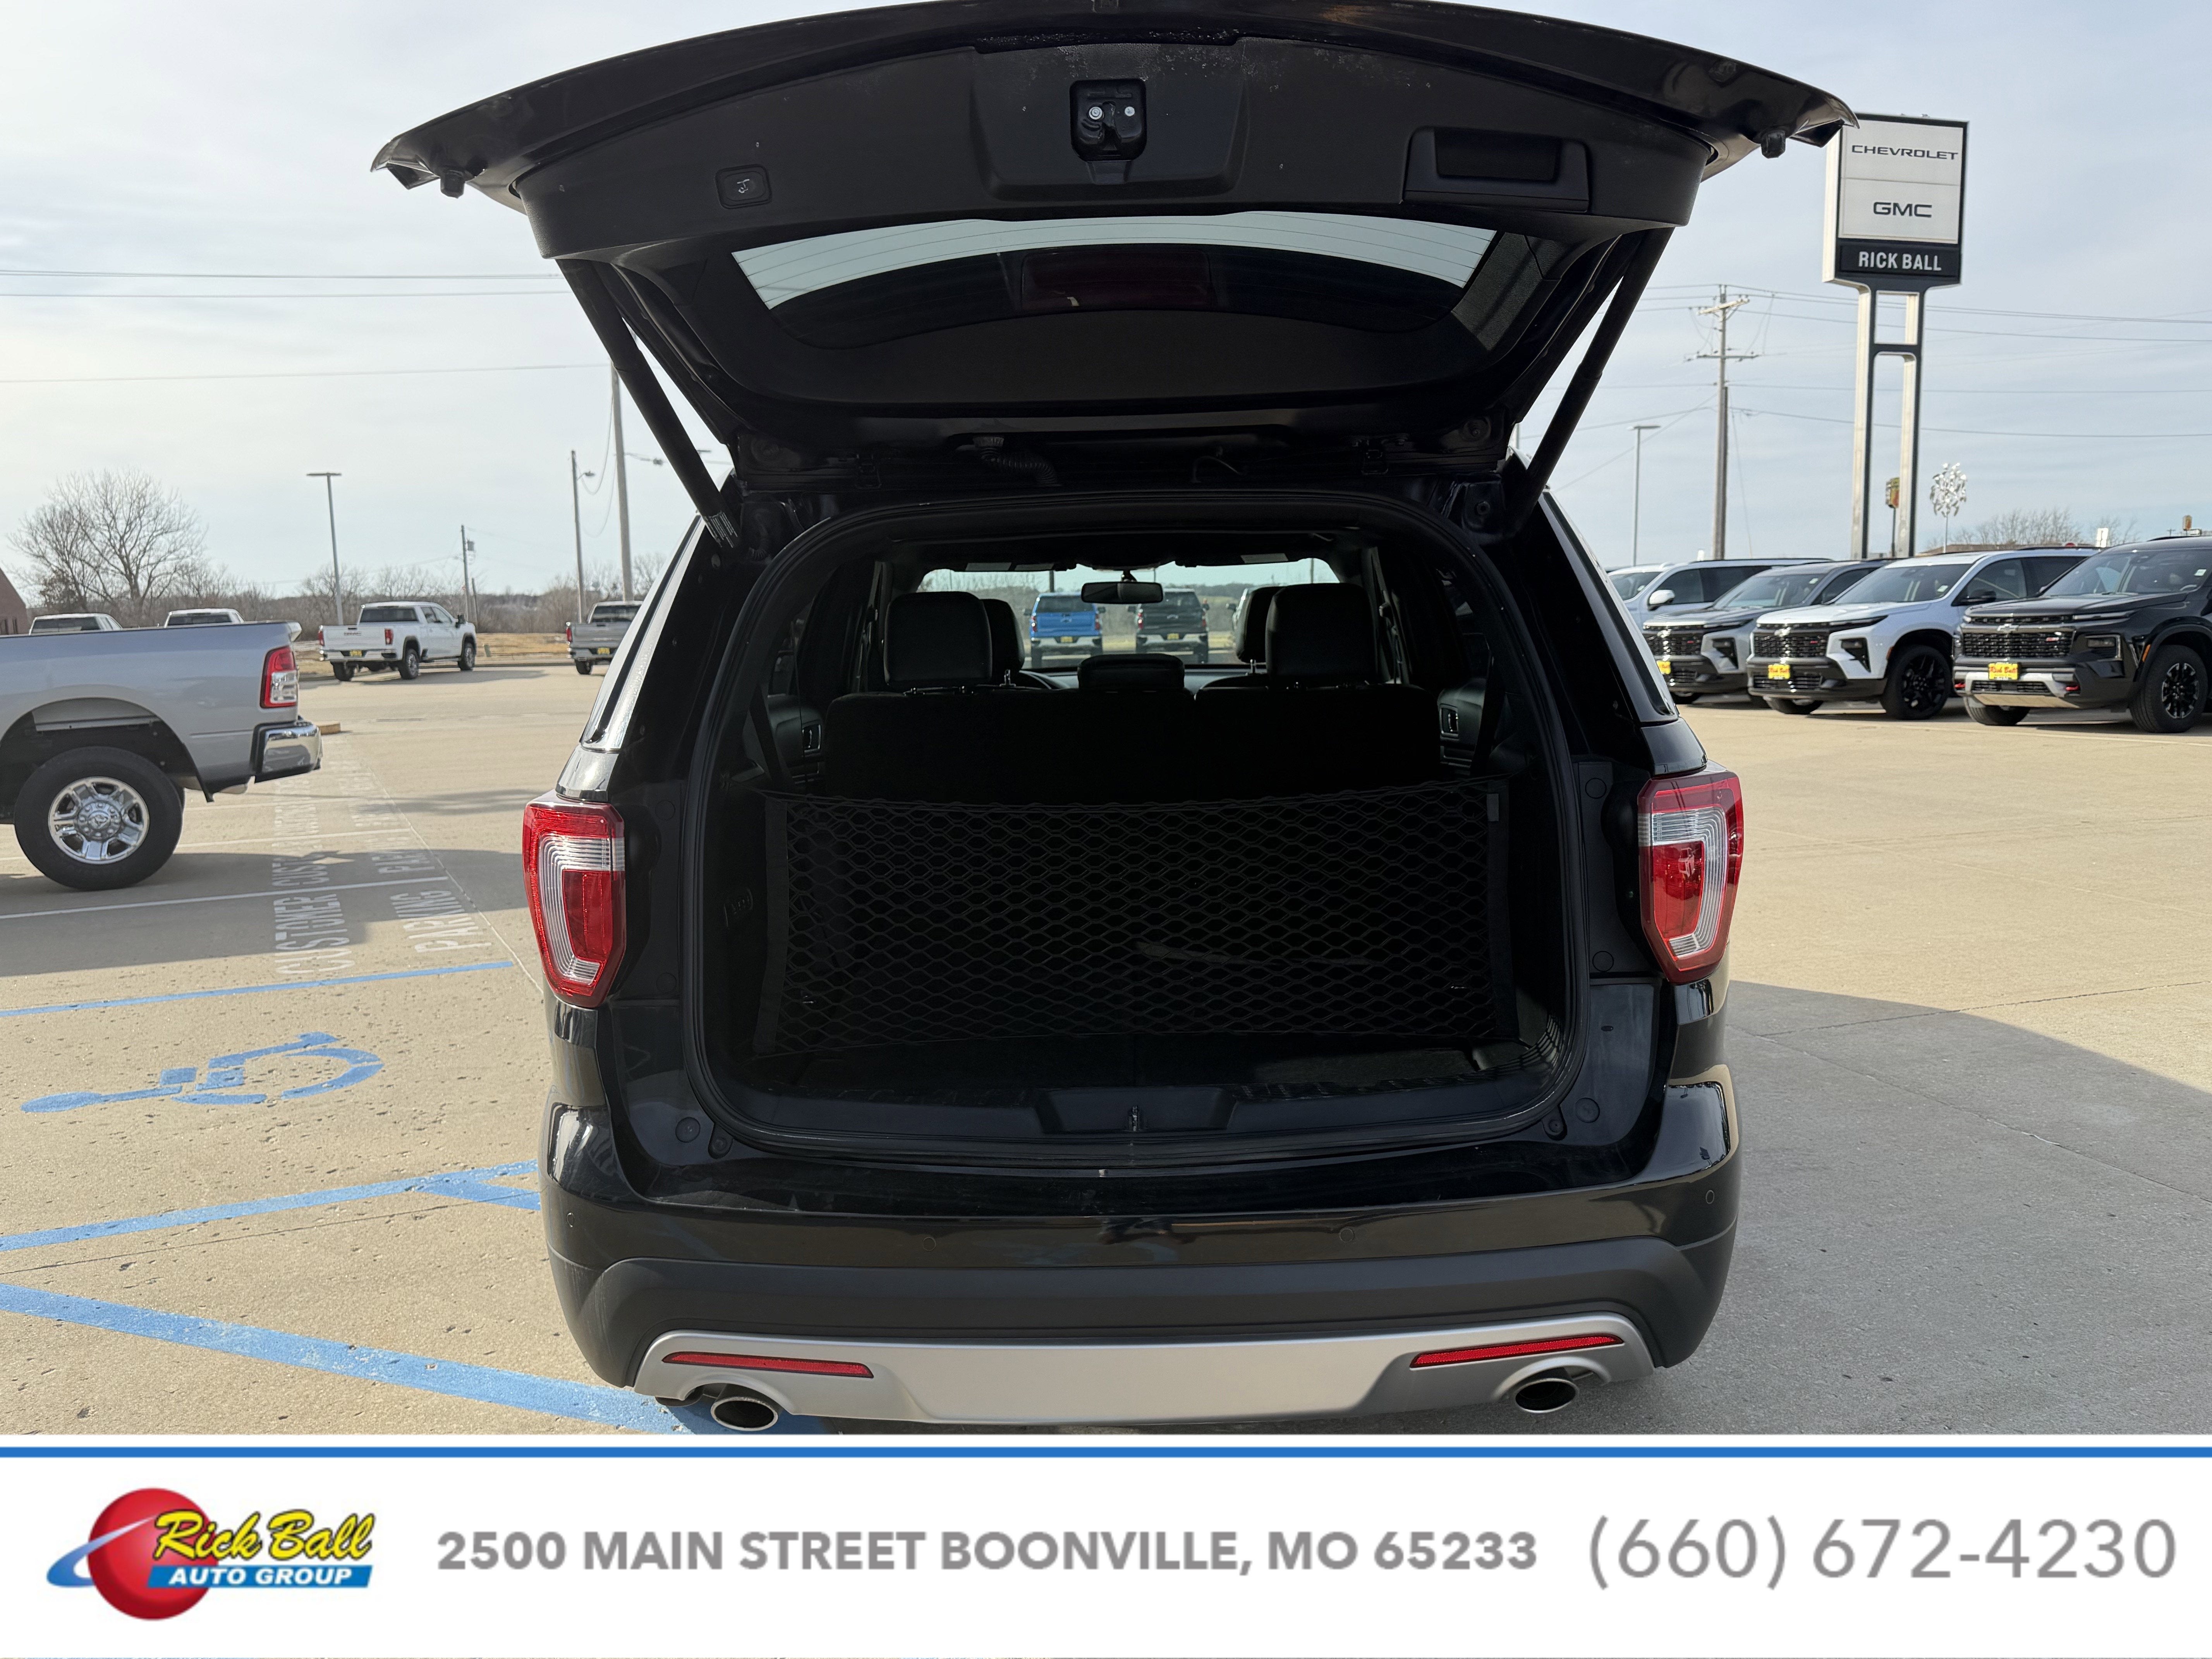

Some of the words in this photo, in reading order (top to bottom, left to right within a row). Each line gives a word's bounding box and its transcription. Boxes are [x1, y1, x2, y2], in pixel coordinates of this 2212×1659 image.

[1851, 145, 1958, 160] CHEVROLET
[1873, 201, 1932, 218] GMC
[1859, 251, 1898, 269] RICK
[1902, 254, 1942, 271] BALL
[390, 891, 492, 953] PARKING
[273, 893, 355, 974] CUSTOMER
